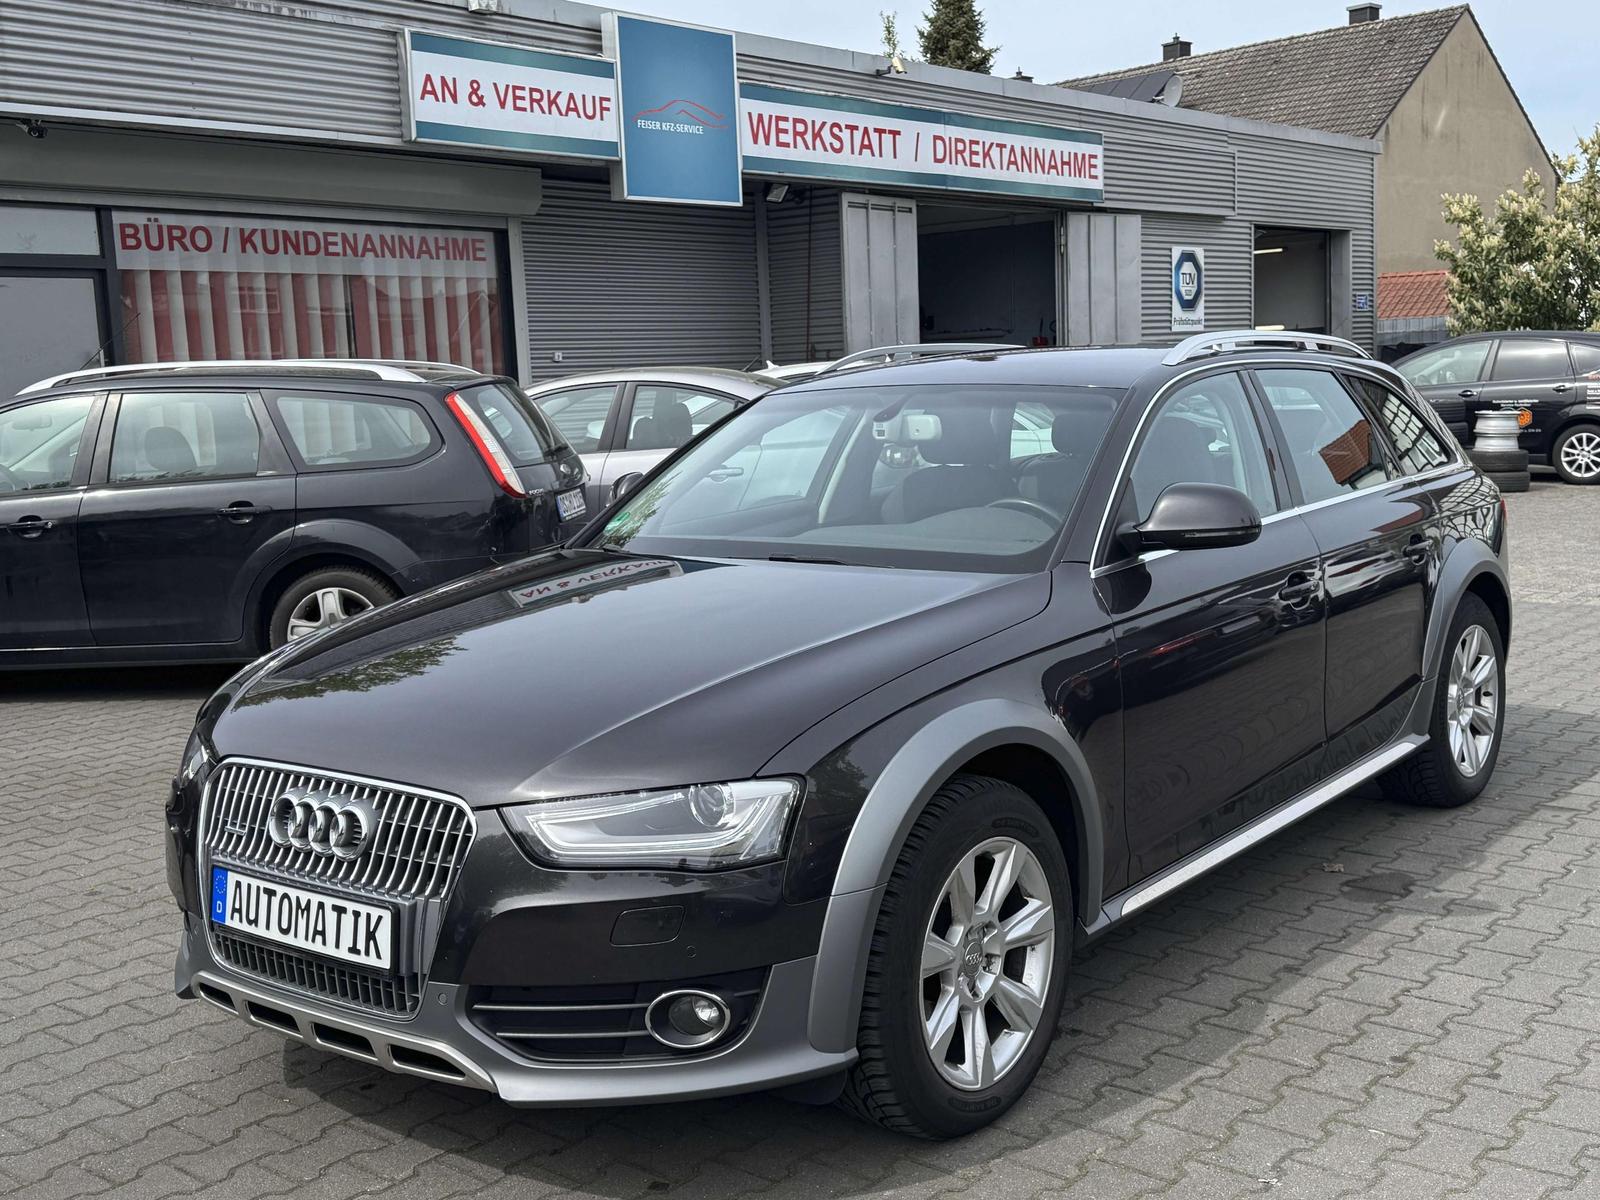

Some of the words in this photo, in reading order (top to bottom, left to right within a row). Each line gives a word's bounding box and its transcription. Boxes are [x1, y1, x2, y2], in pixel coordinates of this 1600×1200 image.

[420, 74, 458, 105] AN
[467, 79, 487, 108] &
[492, 82, 611, 121] VERKAUF
[637, 120, 660, 130] FEISER
[661, 122, 704, 134] KFZ-SERVICE
[748, 112, 901, 160] WERKSTATT
[914, 132, 920, 162] /
[932, 135, 1099, 180] DIREKTANNAHME
[119, 217, 213, 253] BÜRO
[222, 227, 230, 253] /
[240, 228, 487, 262] KUNDENANNAHME
[216, 901, 223, 912] D
[230, 880, 384, 960] AUTOMATIK
